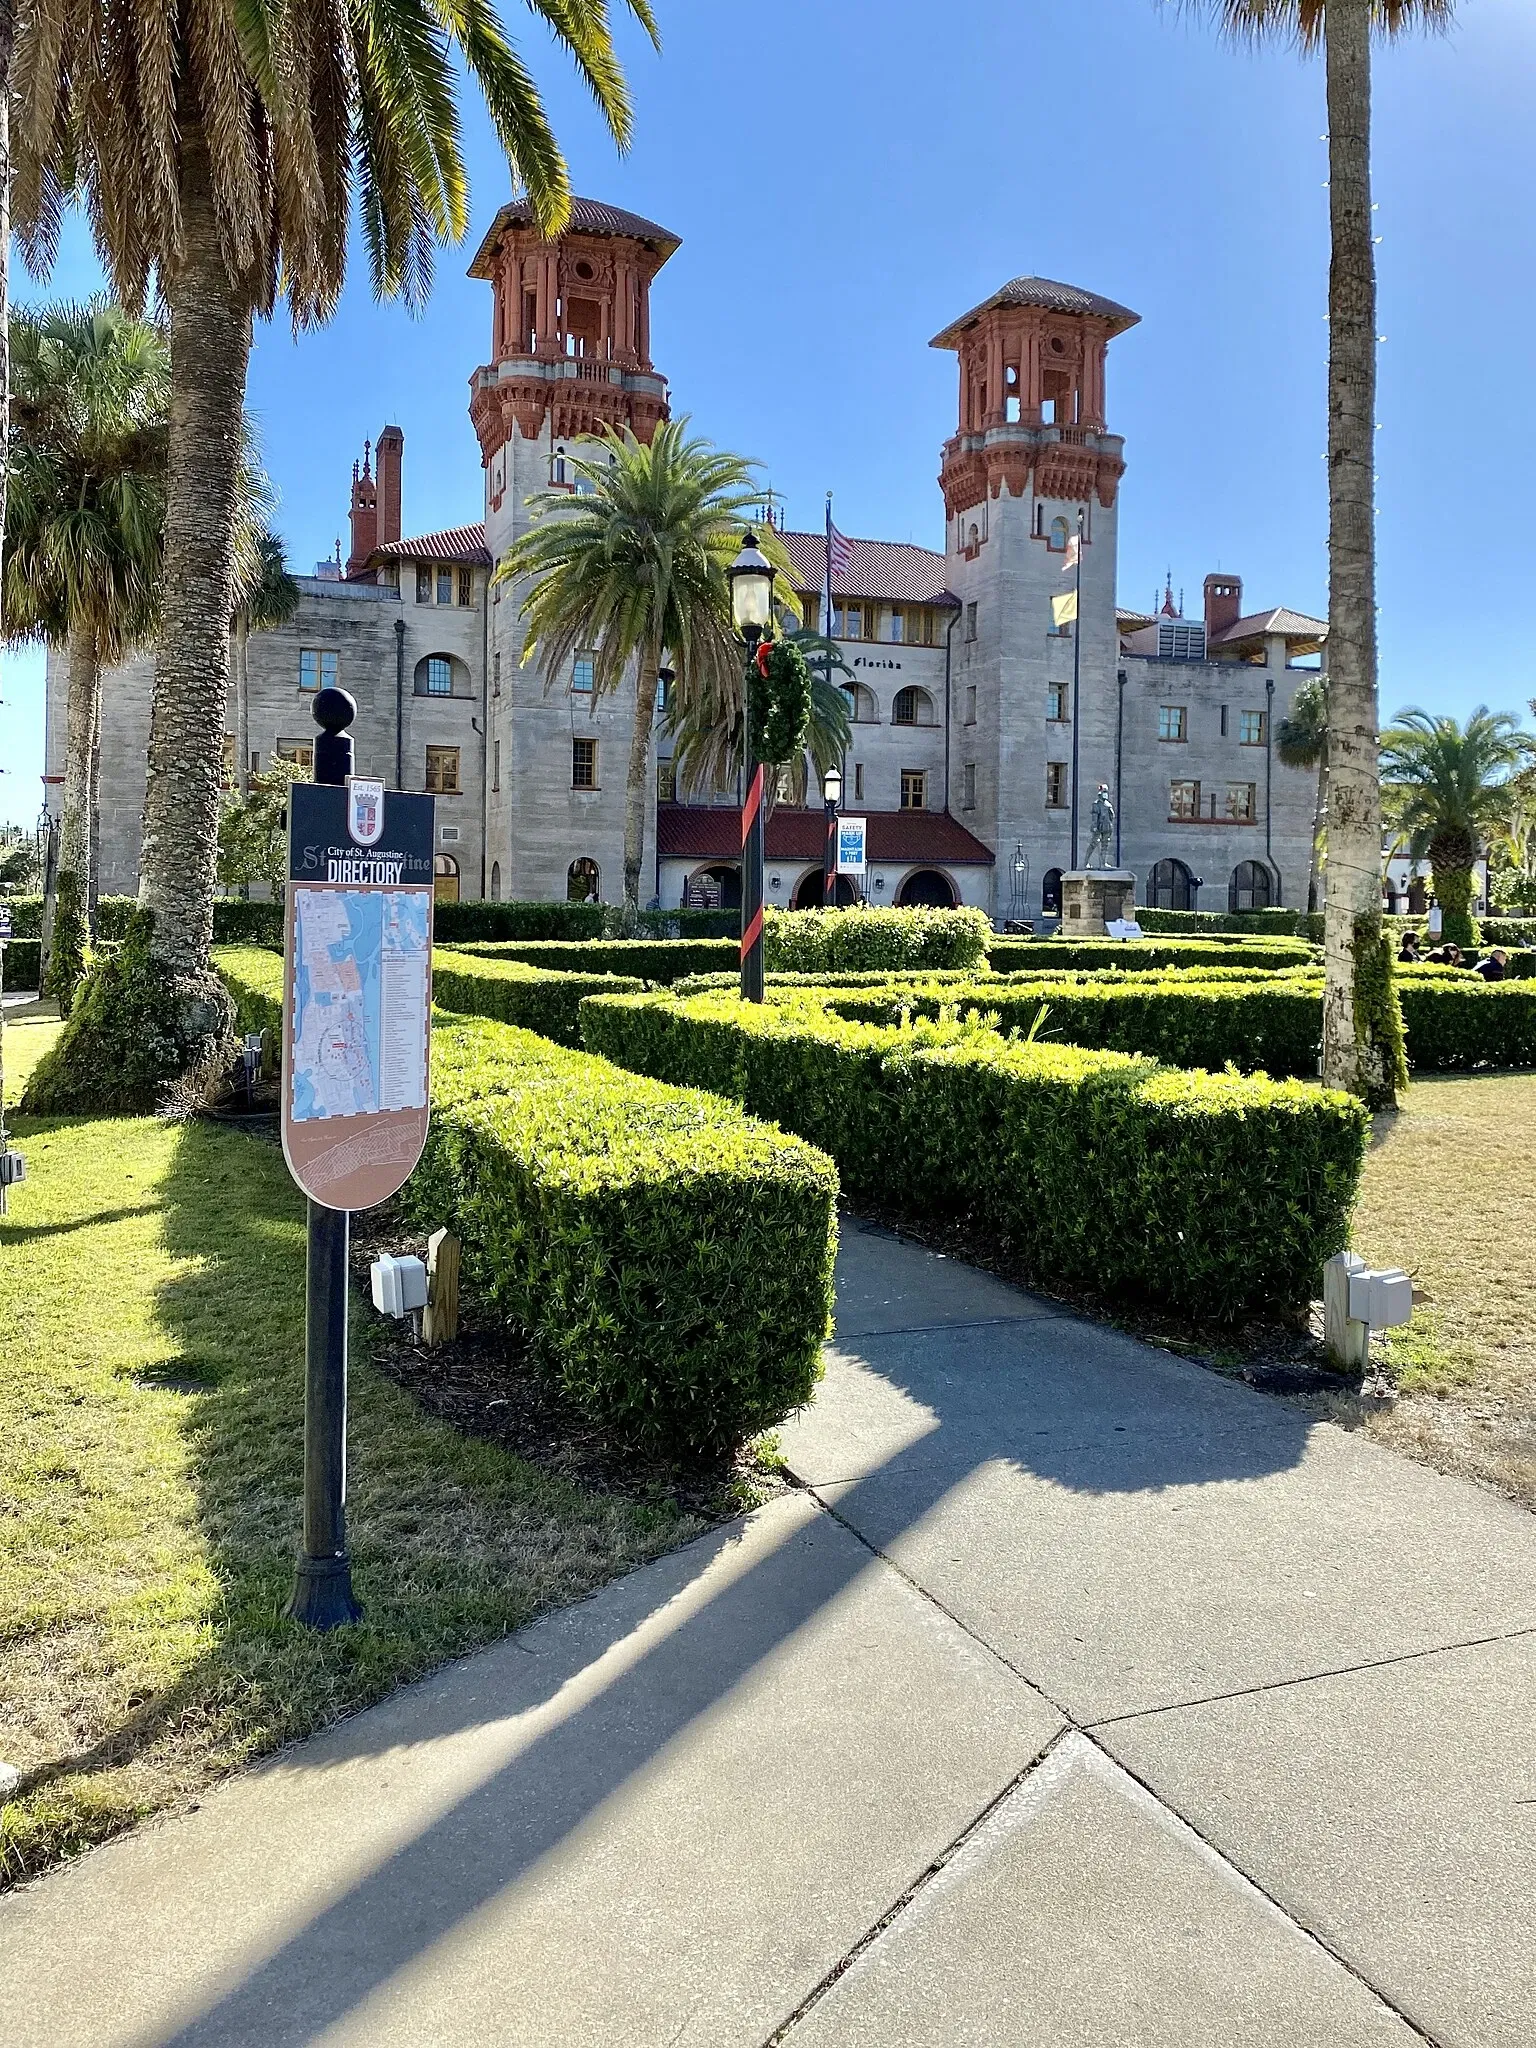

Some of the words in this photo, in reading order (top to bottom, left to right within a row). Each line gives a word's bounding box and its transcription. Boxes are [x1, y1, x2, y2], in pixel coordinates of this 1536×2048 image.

[854, 657, 902, 670] Florida
[328, 846, 345, 860] City
[345, 847, 355, 857] of
[355, 848, 364, 858] St.
[366, 849, 403, 860] Augustine
[328, 859, 403, 885] DIRECTORY
